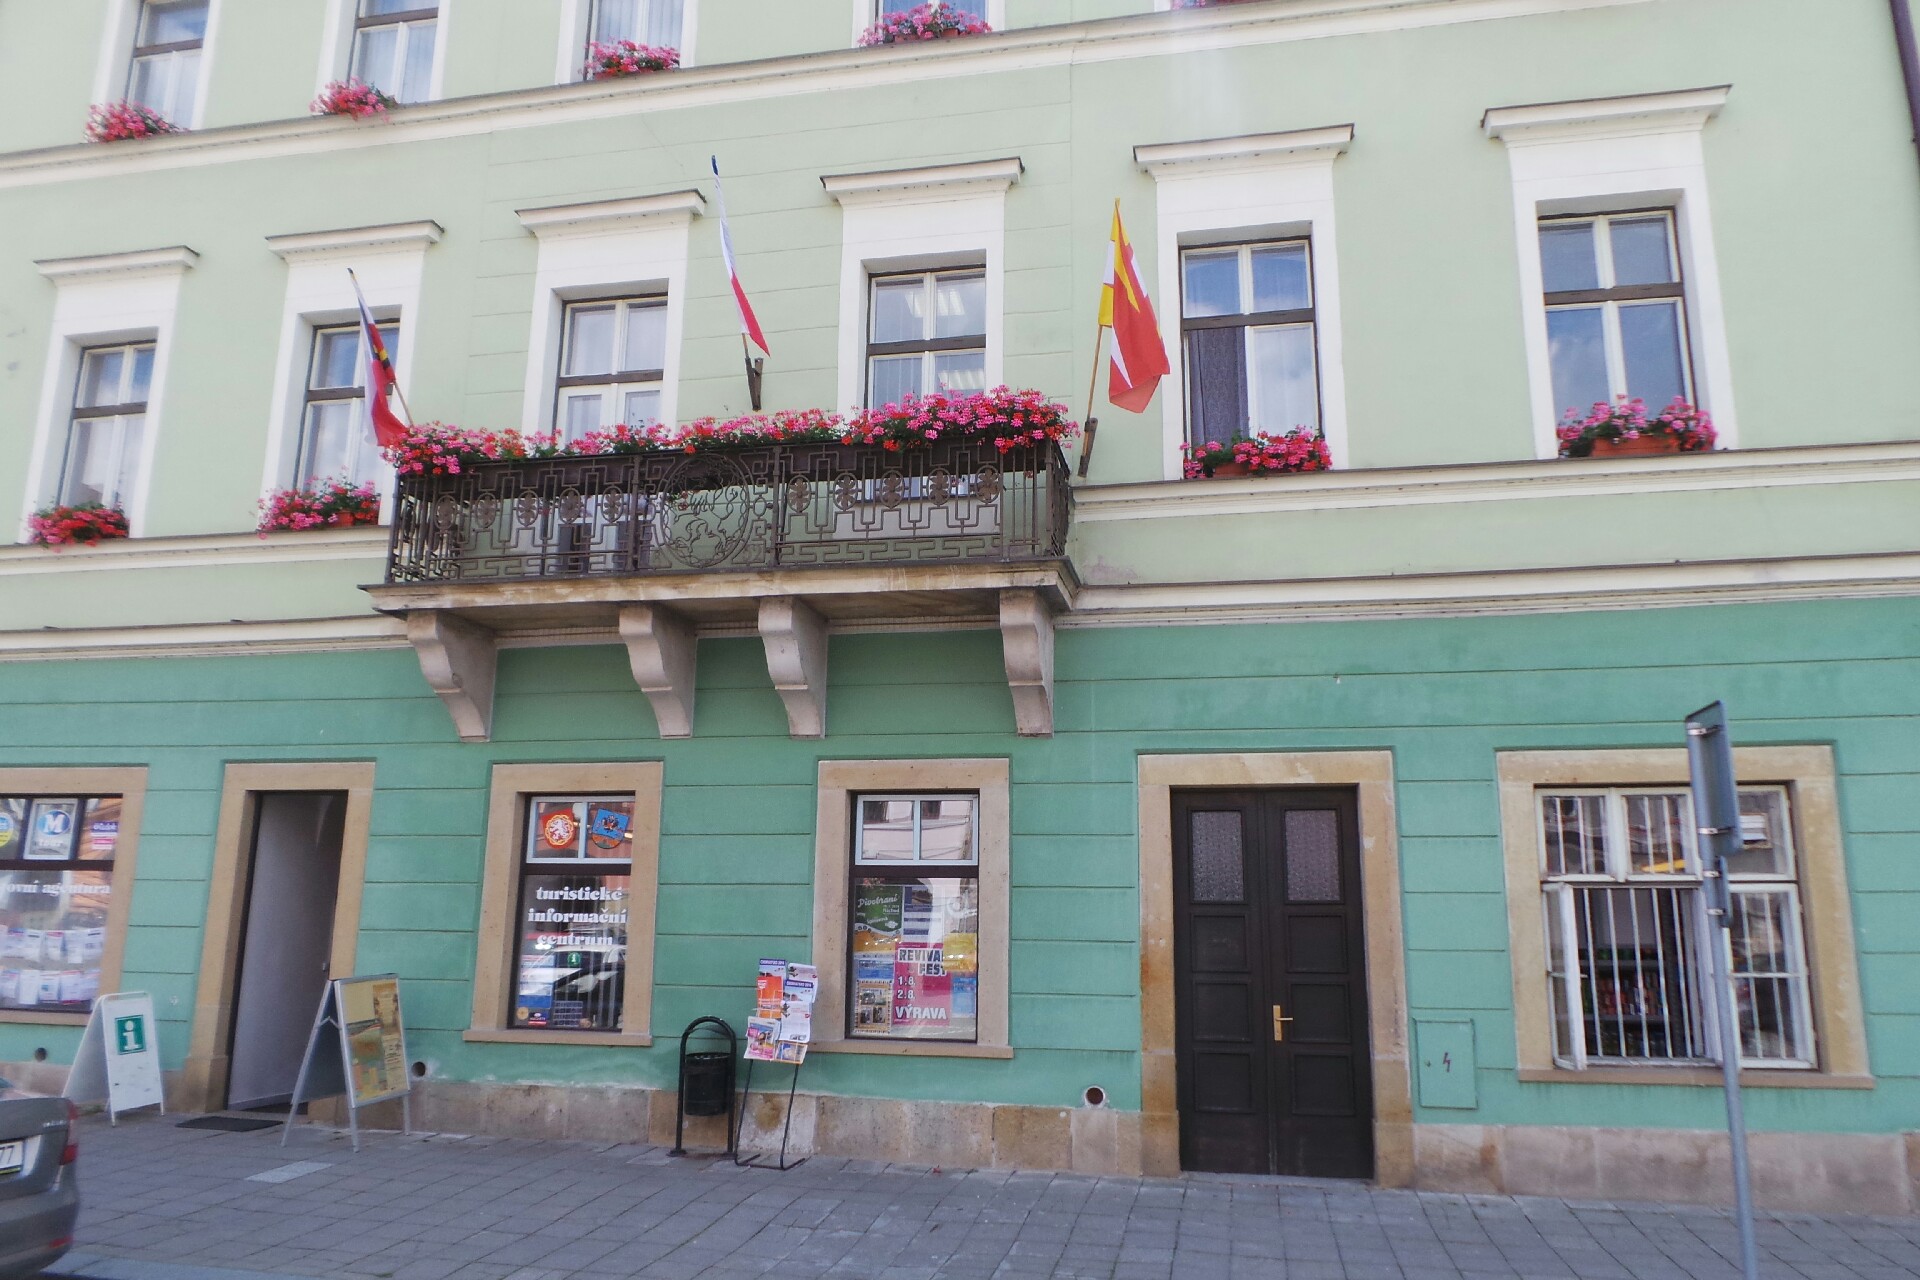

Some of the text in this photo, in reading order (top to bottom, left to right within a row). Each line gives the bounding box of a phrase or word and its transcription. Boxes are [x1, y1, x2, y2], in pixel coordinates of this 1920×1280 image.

[536, 886, 623, 901] turistické
[528, 908, 627, 923] informační
[537, 932, 613, 945] centrum
[898, 949, 944, 962] REVIVA
[895, 1004, 947, 1020] VÝRAVA
